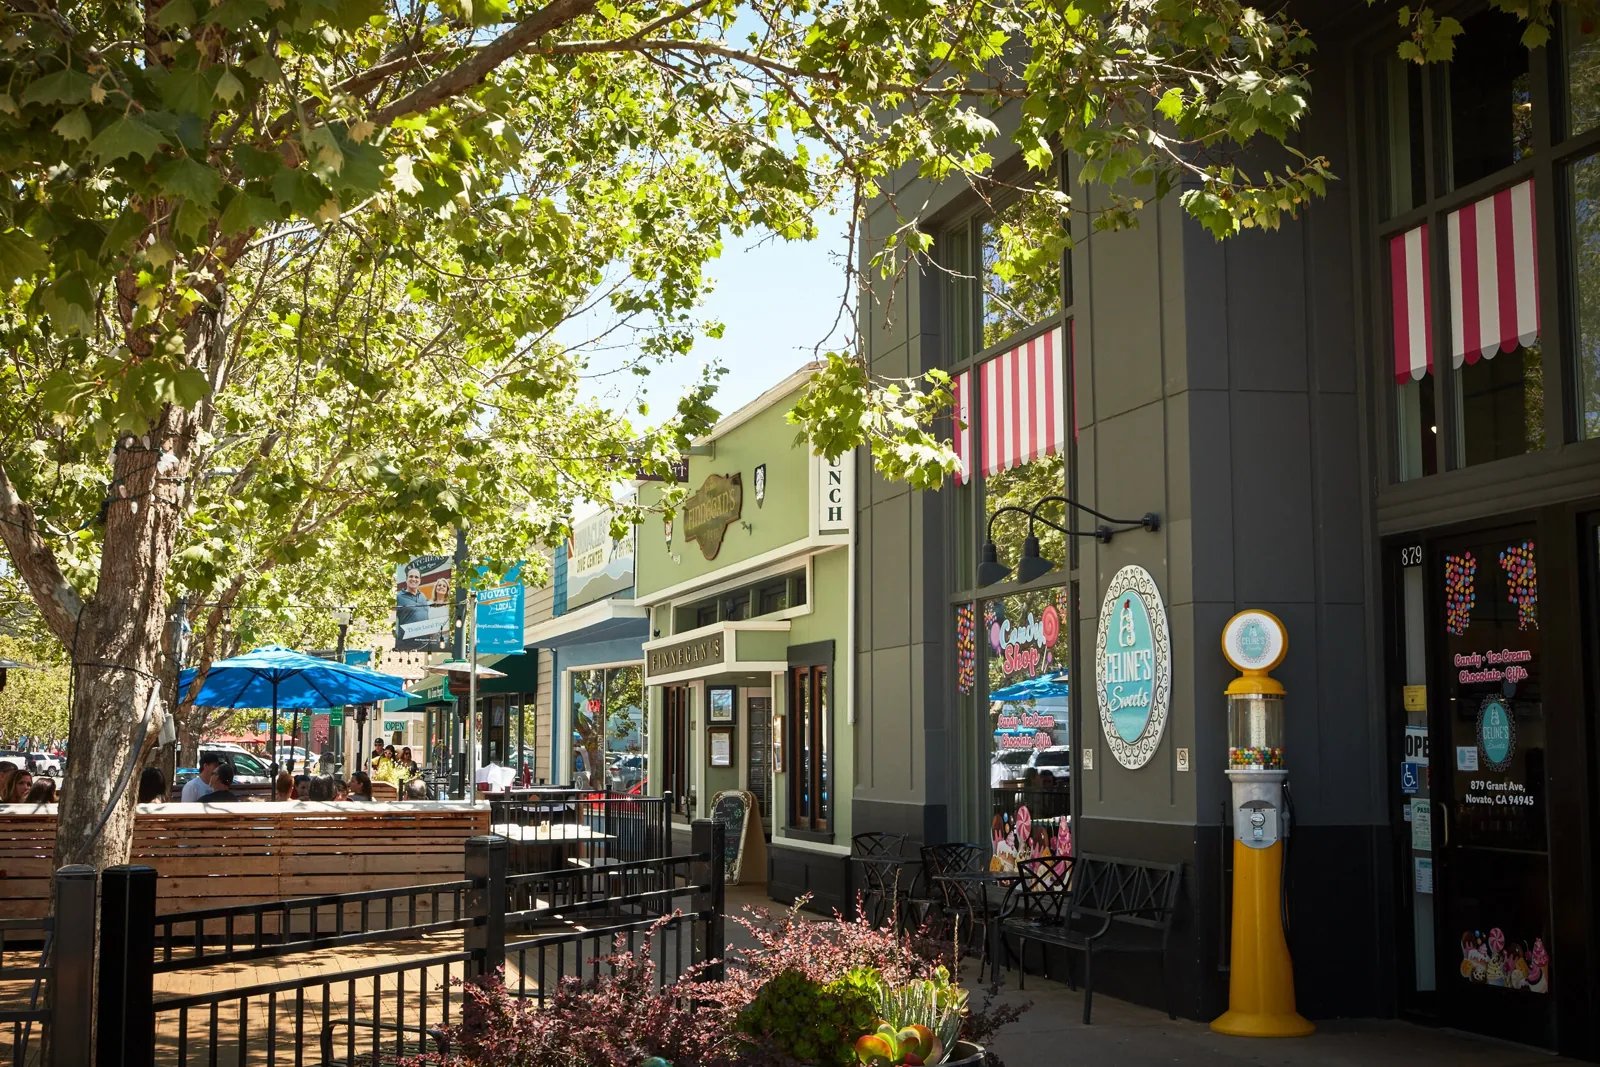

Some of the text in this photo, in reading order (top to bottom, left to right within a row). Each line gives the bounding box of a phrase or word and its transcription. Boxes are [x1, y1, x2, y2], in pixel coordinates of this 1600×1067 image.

[828, 453, 843, 521] UNCH
[688, 488, 736, 530] FINNEGAN'S
[1401, 545, 1423, 566] 879
[480, 586, 517, 601] NOVATO
[495, 602, 512, 611] LOCAL
[1000, 612, 1046, 649] Candy
[652, 639, 720, 671] FINNEGAN'S
[1003, 643, 1040, 676] Shop
[1454, 648, 1532, 668] Candy Ice Cream
[1106, 649, 1152, 684] CELINE'S
[1459, 665, 1528, 684] Chocolate Gifts
[1109, 685, 1149, 712] Sweets
[385, 721, 405, 730] OPEN
[998, 712, 1055, 731] Candy Ice Cream
[1002, 732, 1052, 751] Chocolate Gifts
[1482, 726, 1509, 740] CELINE'S
[1405, 734, 1430, 758] OPE
[1470, 780, 1526, 793] 879 Grant Ave,
[1465, 793, 1534, 806] Novato, CA 94945
